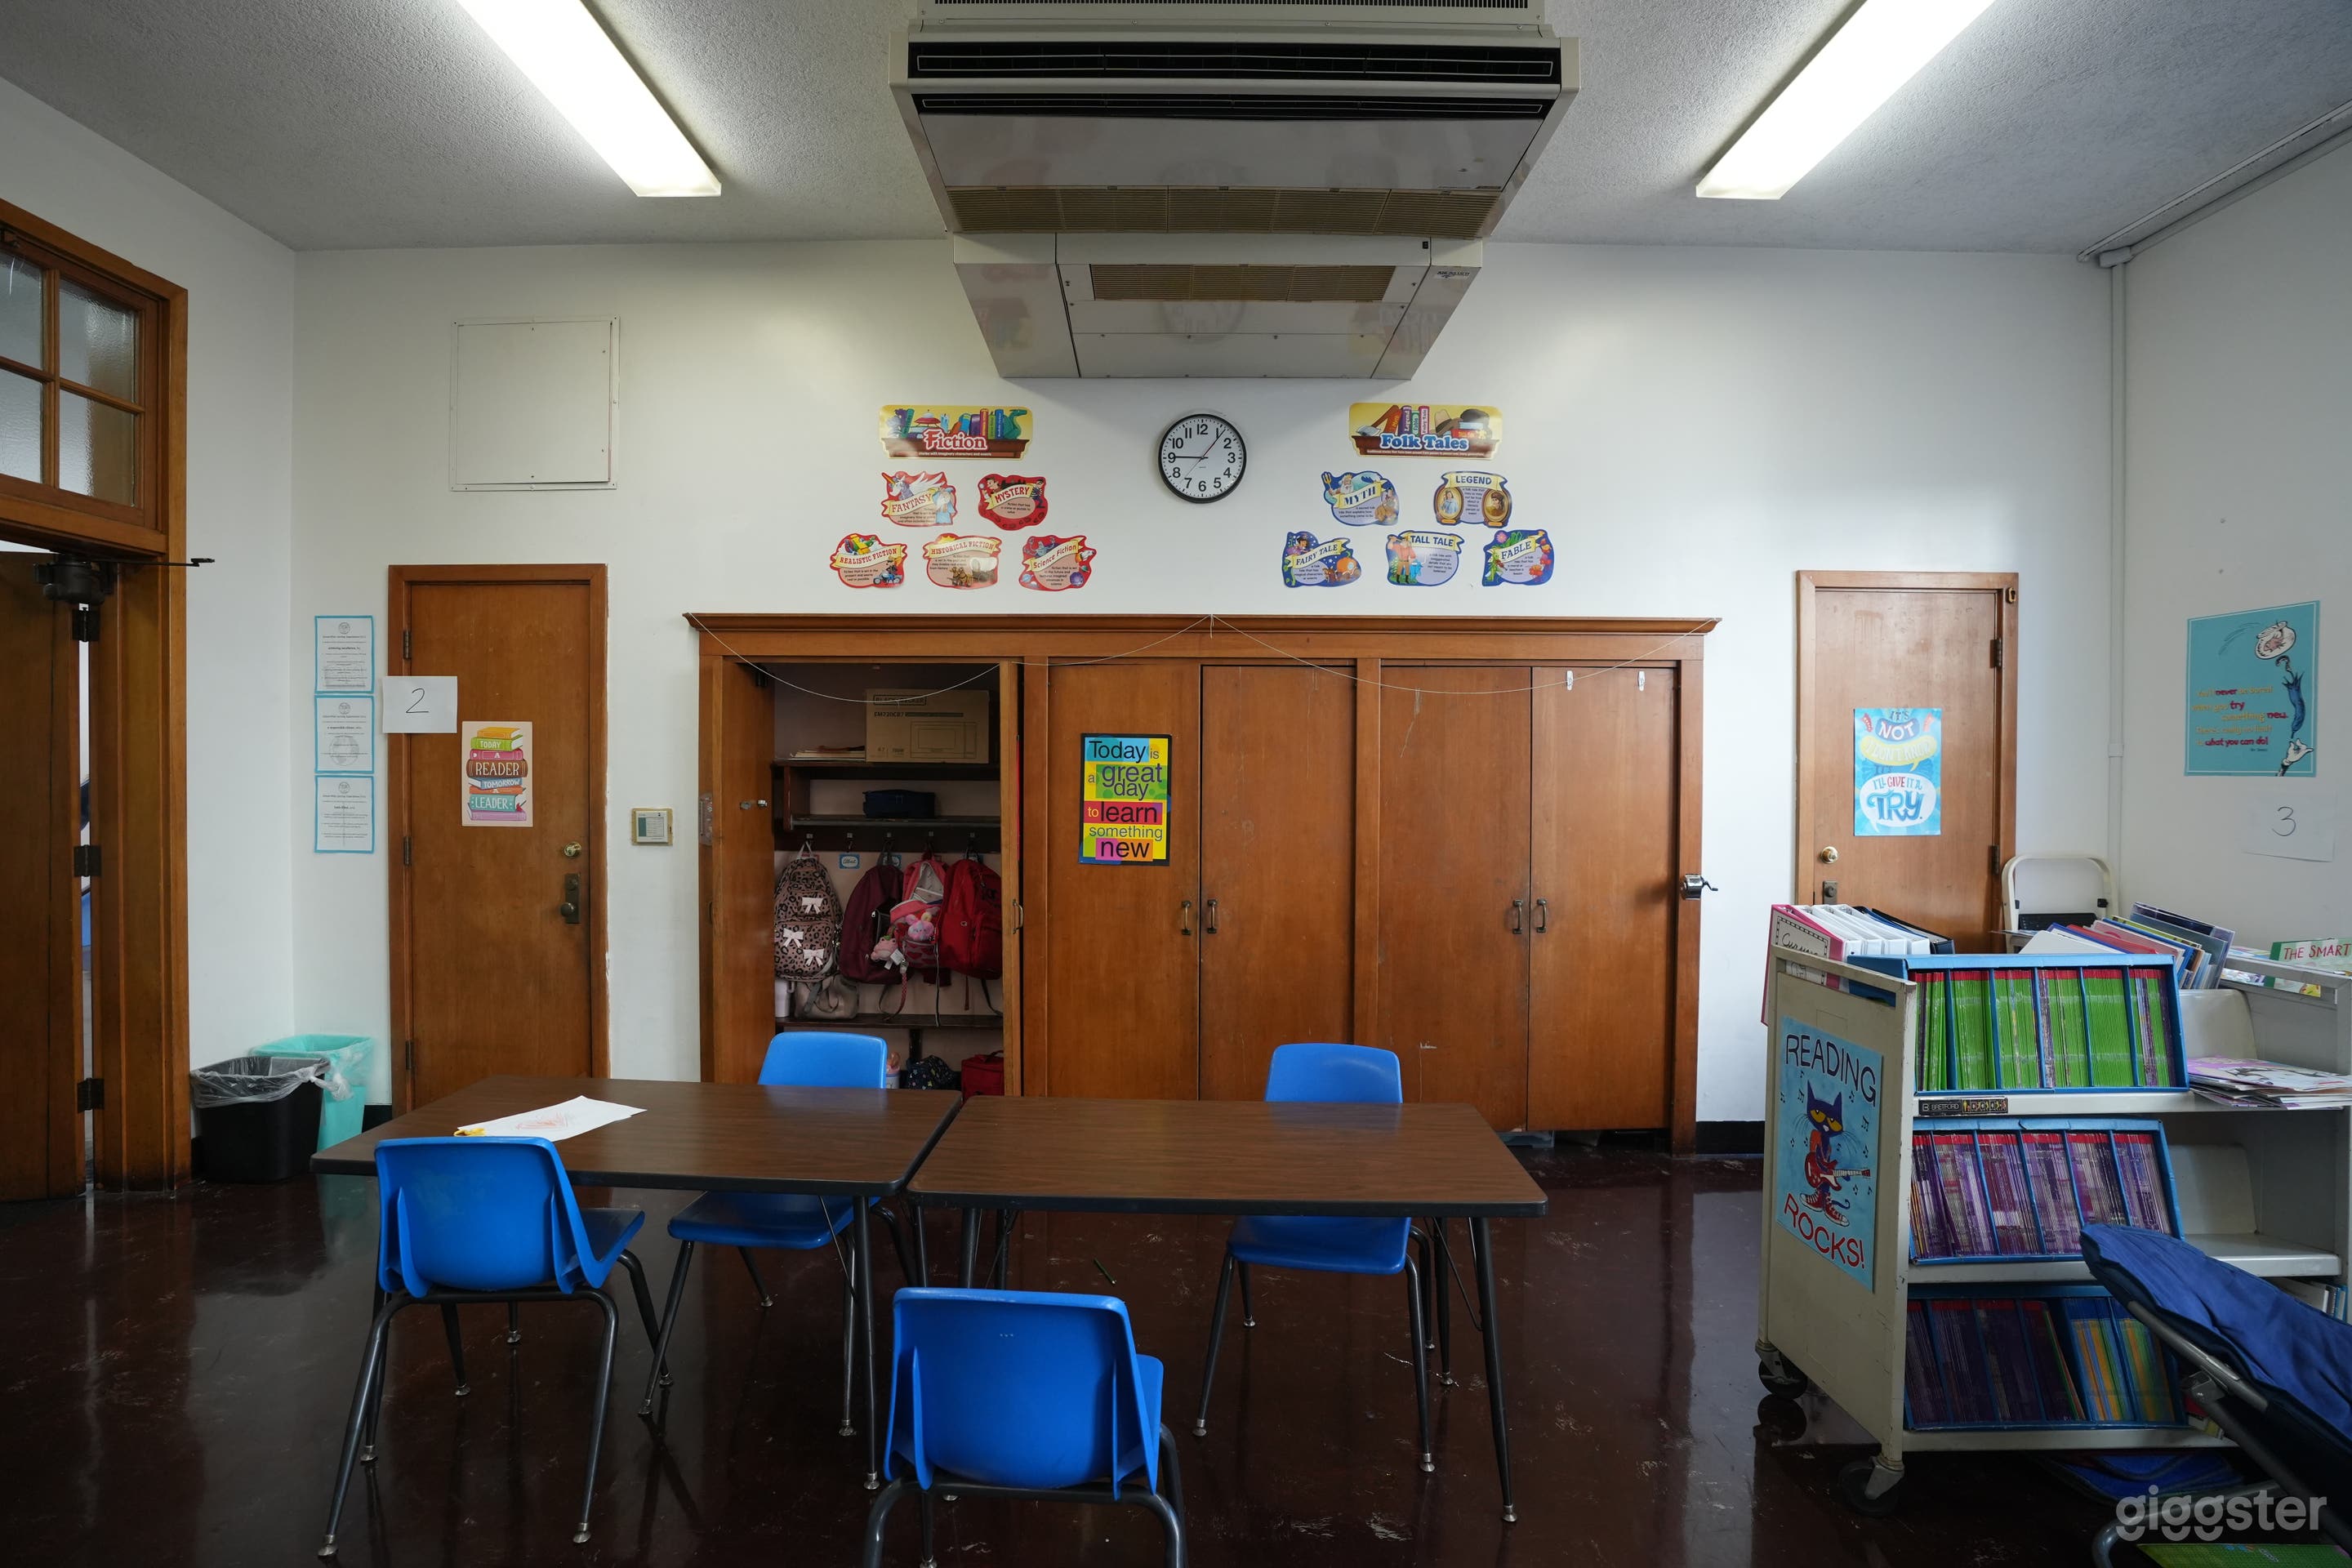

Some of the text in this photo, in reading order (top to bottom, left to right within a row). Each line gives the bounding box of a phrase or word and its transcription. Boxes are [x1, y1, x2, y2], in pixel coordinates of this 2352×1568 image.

[1185, 427, 1192, 439] 11
[1196, 424, 1209, 435] 12
[924, 430, 987, 449] Fiction
[1172, 438, 1184, 449] 10
[1223, 438, 1232, 449] 2
[1381, 434, 1468, 449] Folk Tales
[1168, 452, 1176, 463] 9
[1227, 452, 1236, 463] 3
[1172, 466, 1181, 479] 8
[1223, 467, 1232, 479] 4
[1184, 478, 1192, 489] 7
[1198, 480, 1206, 492] 6
[1214, 478, 1222, 489] 5
[1455, 475, 1492, 485] LEGEND
[994, 487, 1030, 504] MYSTERY
[1344, 486, 1376, 505] MYTH
[892, 493, 932, 513] FANTASY
[931, 541, 994, 555] HISTORICAL FICTION
[1410, 535, 1454, 547] TALL TALE
[840, 548, 898, 564] REALISTIC FICTION
[1033, 544, 1077, 569] Science Fiction
[1296, 544, 1338, 565] FAIRY TALE
[1501, 541, 1531, 559] FABLE
[405, 688, 430, 714] 2
[2230, 701, 2245, 710] try
[1890, 710, 1909, 721] IT'S
[1878, 720, 1914, 741] NOT
[480, 740, 501, 749] TODAY
[2205, 737, 2224, 746] what
[2225, 739, 2238, 747] you
[2256, 736, 2269, 745] do!
[1089, 740, 1160, 764] Today is
[475, 762, 519, 776] READER
[1088, 763, 1163, 788] a great
[483, 778, 520, 788] TOMORROW
[1114, 778, 1149, 801] day
[1873, 776, 1922, 790] I'LL GIVE IT A
[475, 796, 509, 809] LEADER
[1088, 801, 1158, 823] to learn
[2271, 805, 2296, 837] 3
[1089, 825, 1163, 842] something
[1101, 840, 1150, 858] new
[2283, 942, 2352, 960] THE SMART
[1785, 1034, 1876, 1108] READING
[1784, 1192, 1865, 1269] ROCKS!
